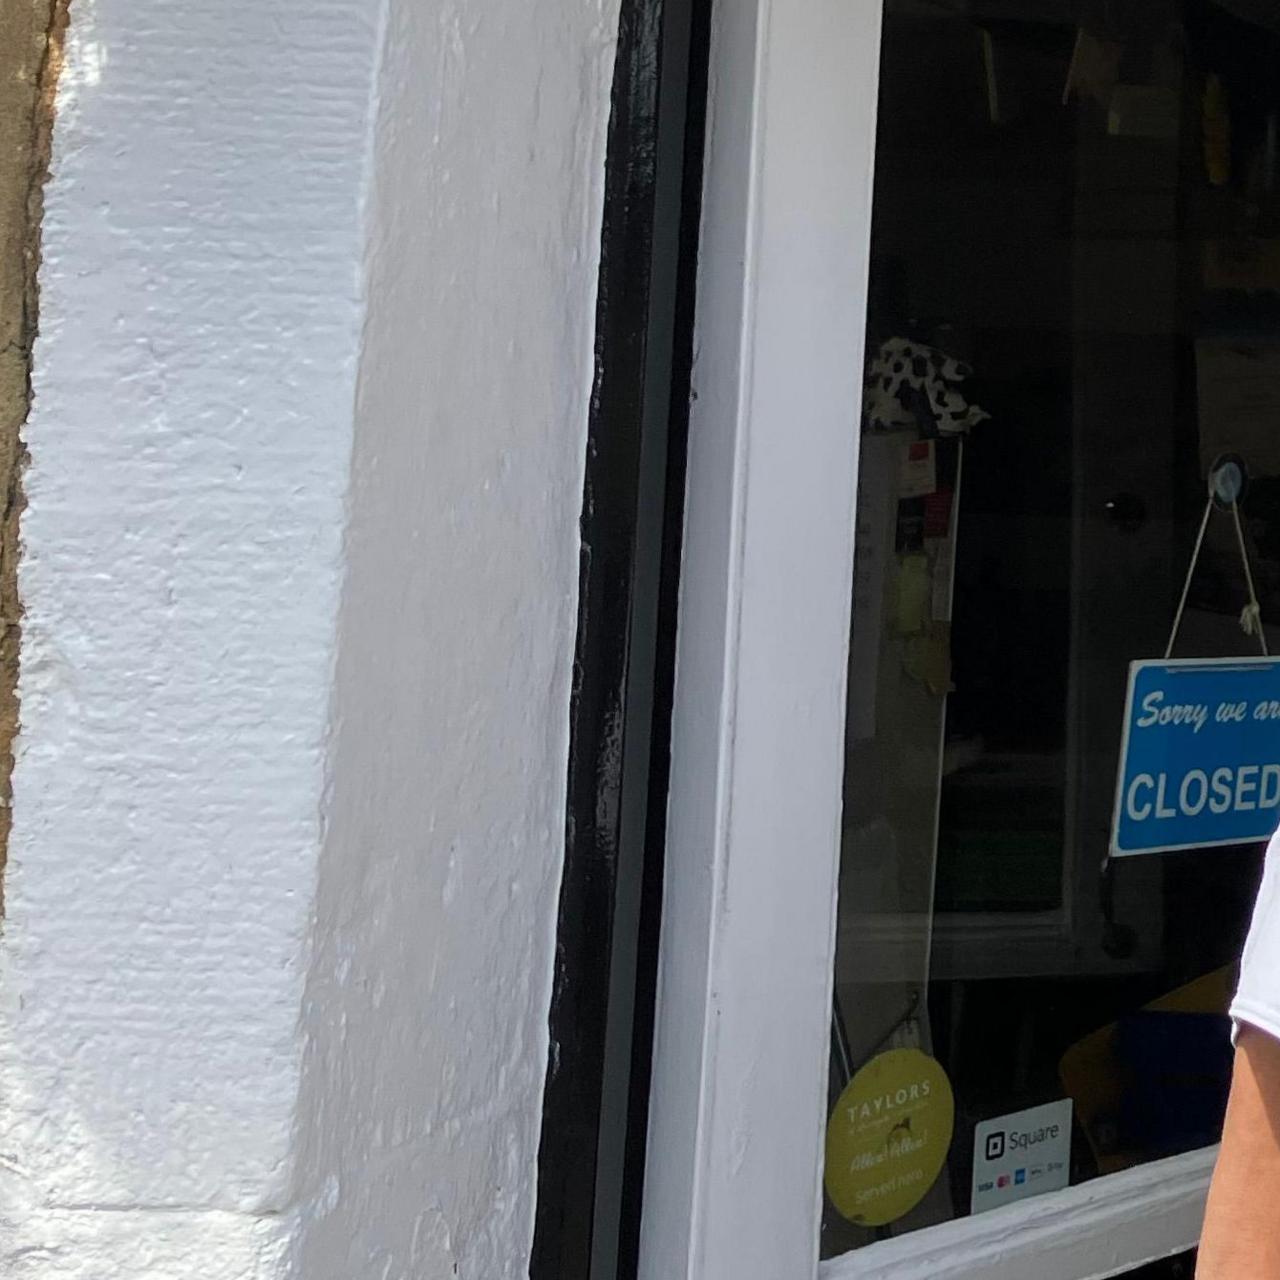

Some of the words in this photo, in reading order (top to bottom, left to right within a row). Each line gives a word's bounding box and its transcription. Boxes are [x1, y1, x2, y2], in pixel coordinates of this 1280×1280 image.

[1137, 691, 1208, 733] Sorry
[1215, 701, 1247, 722] we
[848, 1080, 931, 1122] TAYLORS
[1009, 1124, 1059, 1151] Square
